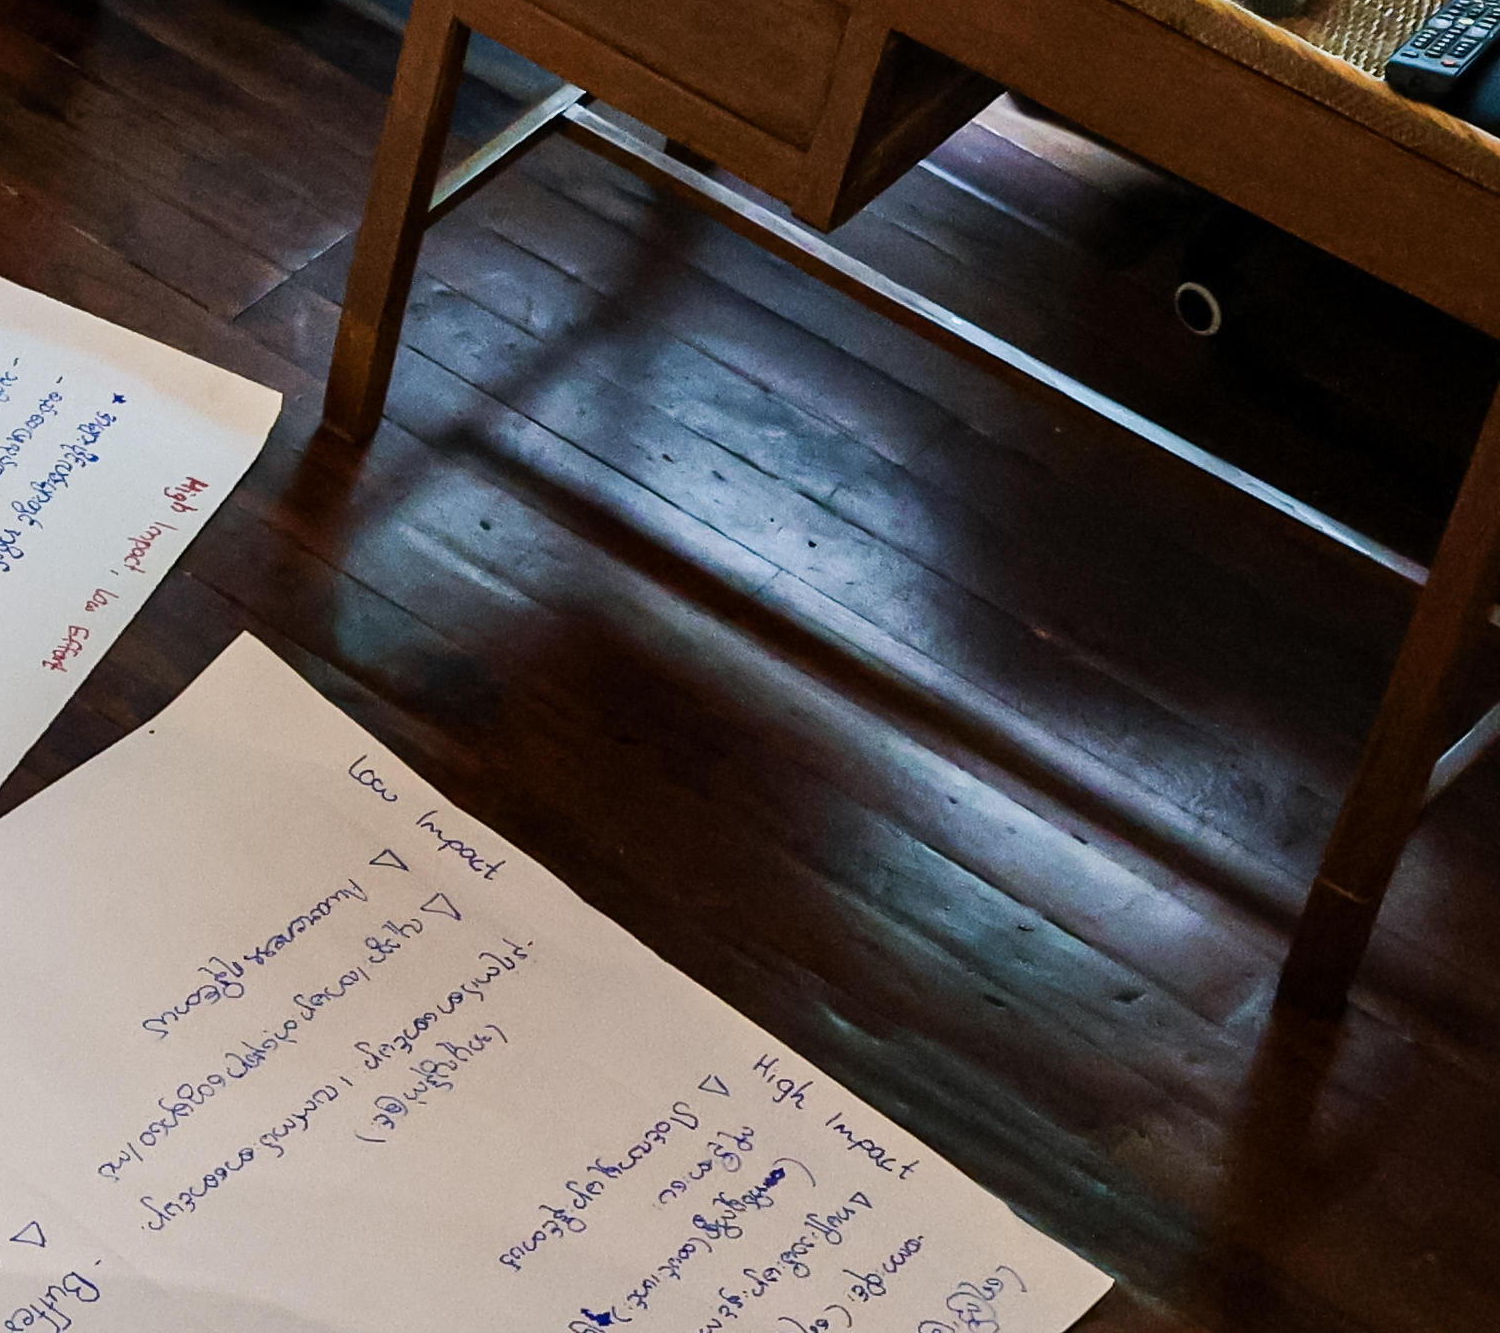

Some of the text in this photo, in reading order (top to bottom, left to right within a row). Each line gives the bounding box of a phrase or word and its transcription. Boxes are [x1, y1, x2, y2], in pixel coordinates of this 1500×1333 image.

[162, 475, 210, 514] High
[347, 753, 507, 882] Low Impact
[751, 1053, 920, 1181] High Impact
